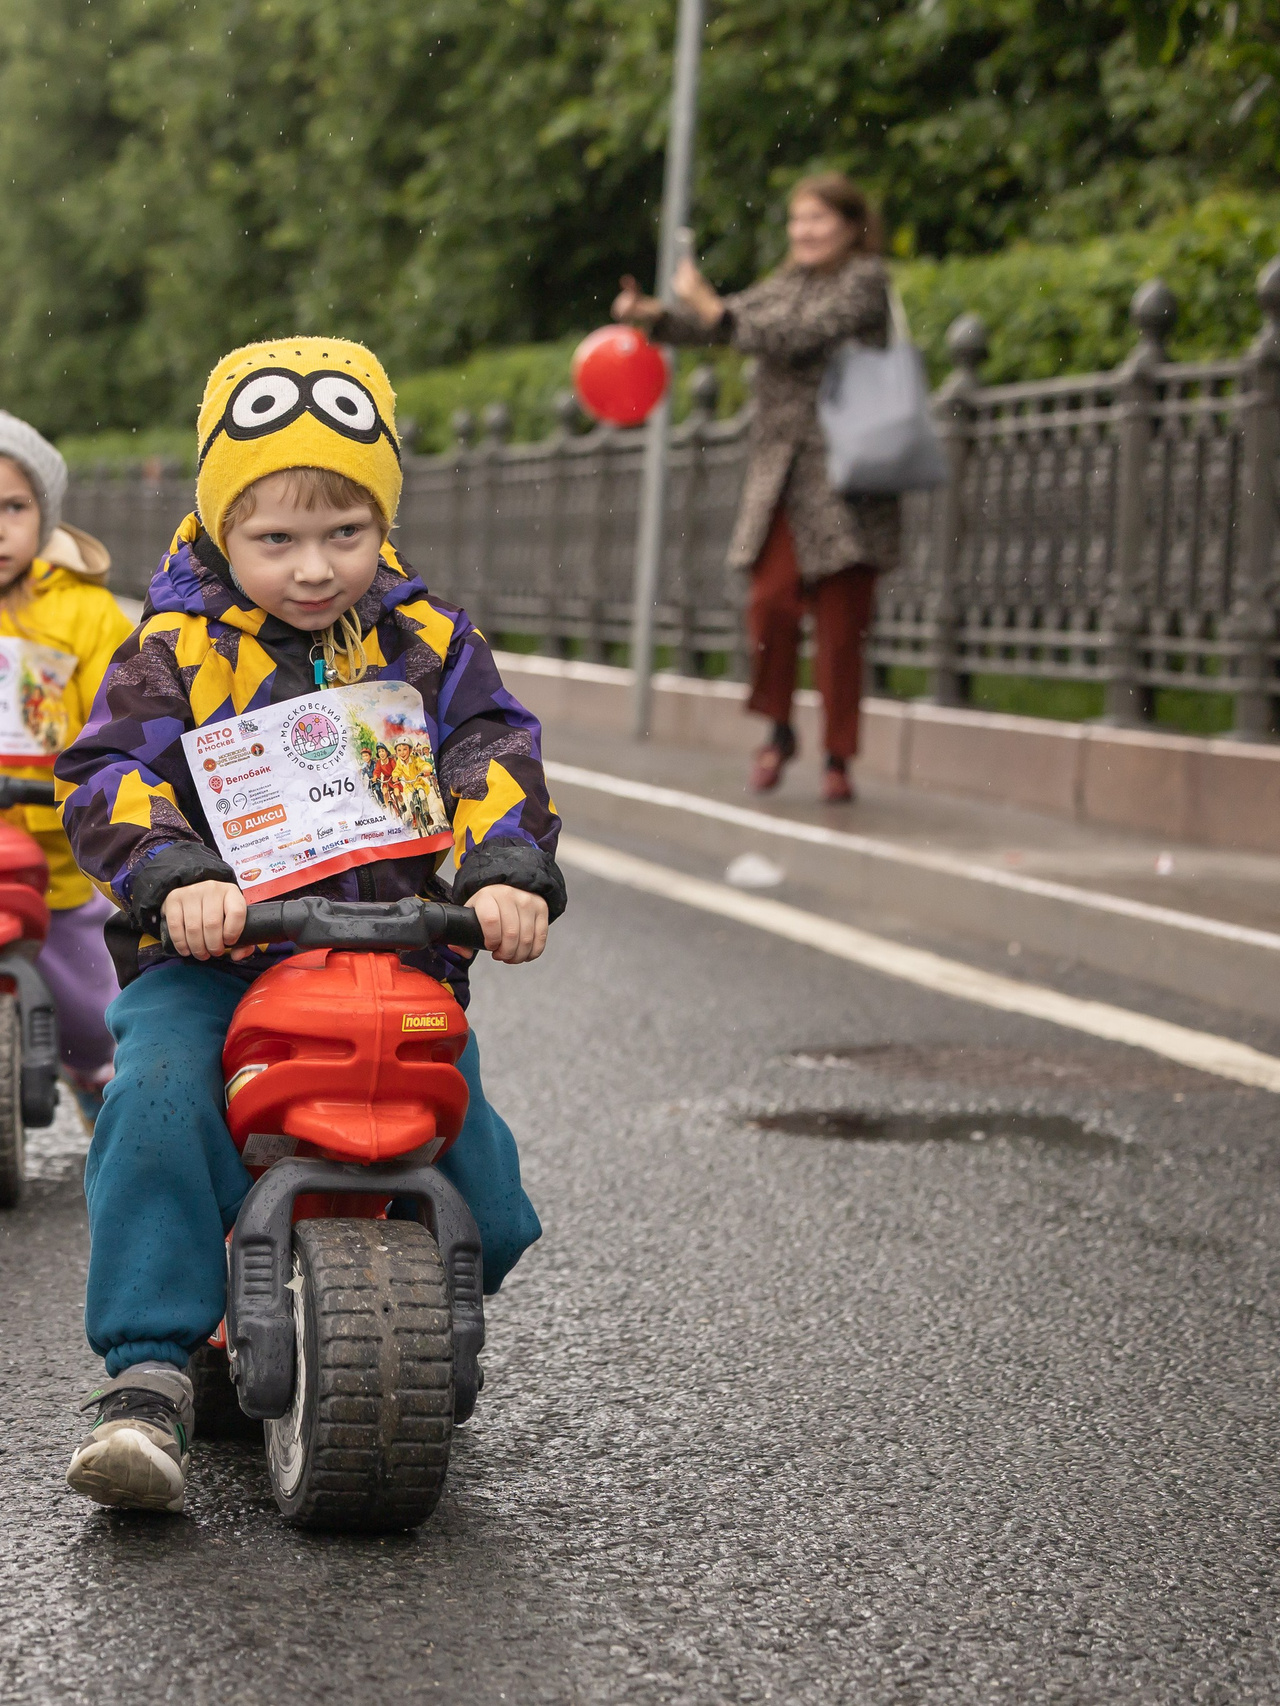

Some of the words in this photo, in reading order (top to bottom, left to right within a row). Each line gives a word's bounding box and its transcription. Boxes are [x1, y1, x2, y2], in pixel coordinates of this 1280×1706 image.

[281, 702, 341, 738] МОСКОВСКИЙ
[197, 728, 232, 747] ЛЕТО
[204, 738, 236, 753] МОСКВЕ
[283, 729, 348, 771] ВЕЛОФЕСТИВАЛЬ
[226, 766, 271, 785] Велобайк
[308, 776, 355, 803] 0476
[245, 809, 285, 830] ДИКСИ
[360, 831, 385, 841] Первые
[406, 1016, 444, 1027] ПОЛЕСЬЕ
